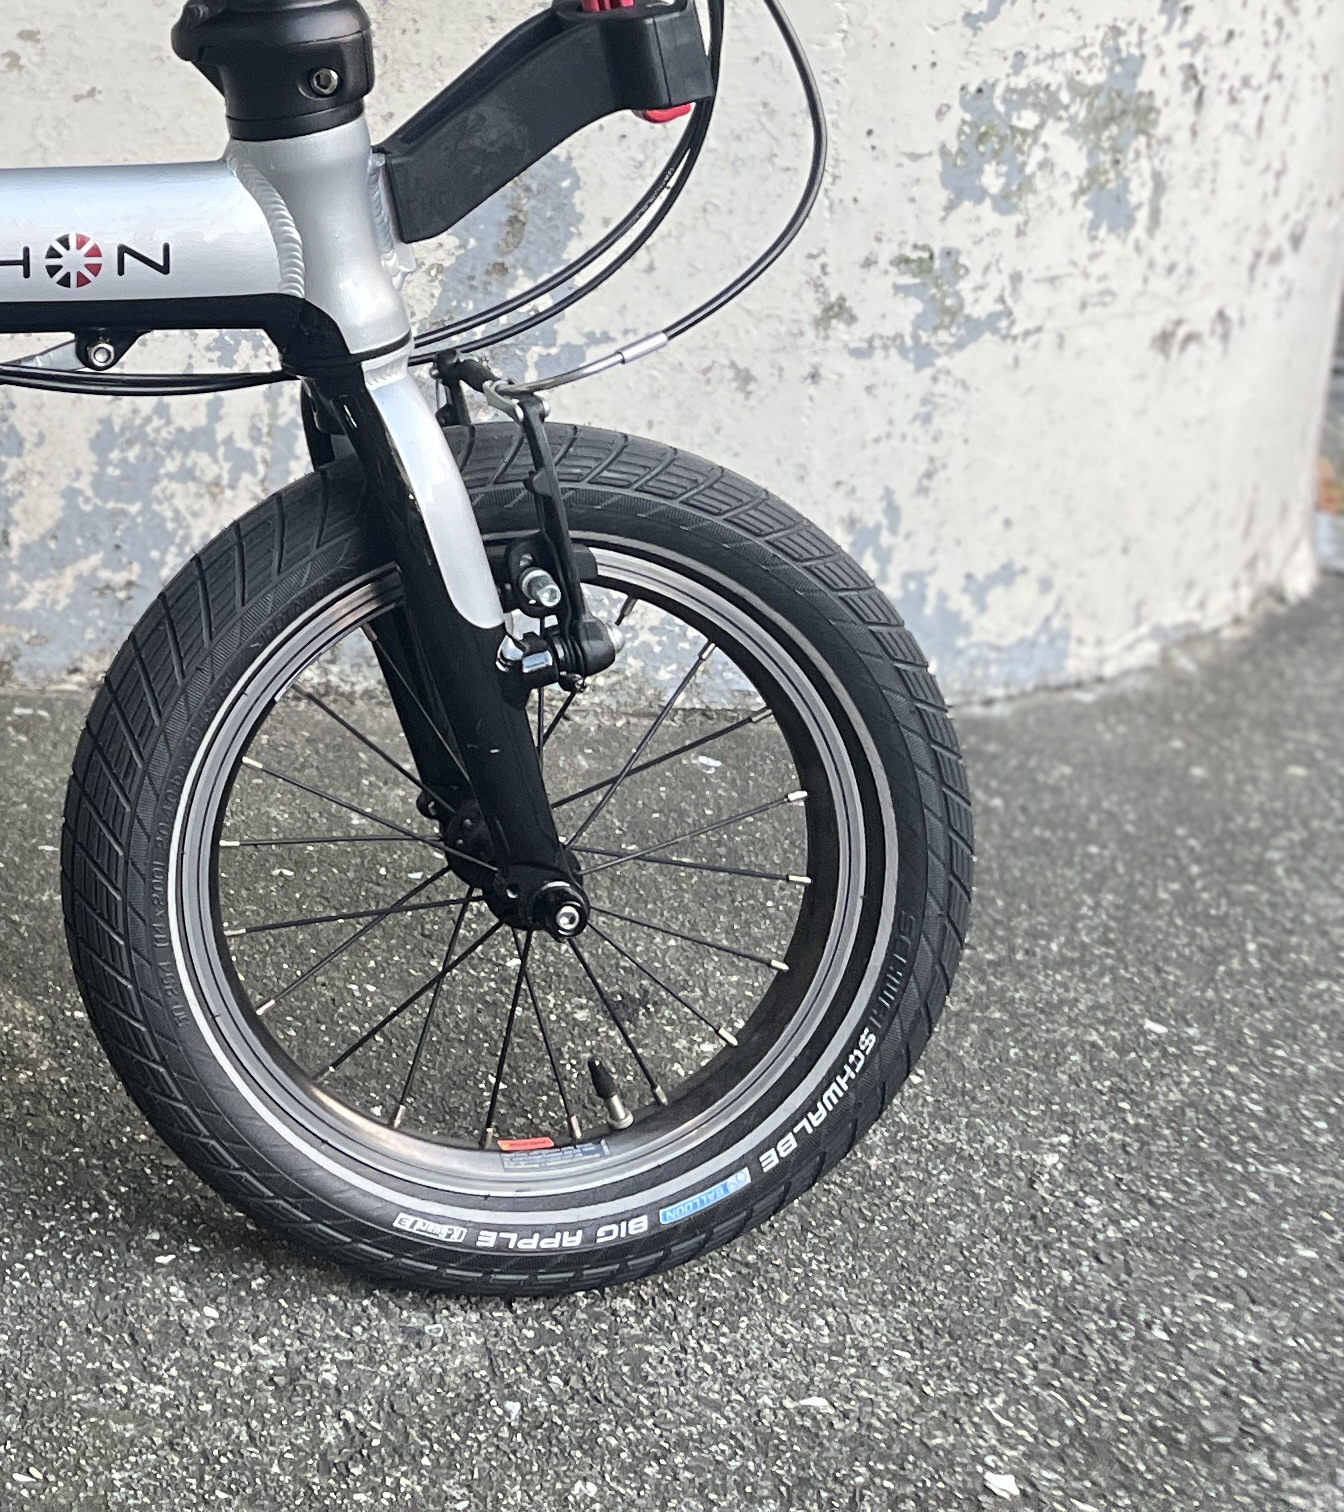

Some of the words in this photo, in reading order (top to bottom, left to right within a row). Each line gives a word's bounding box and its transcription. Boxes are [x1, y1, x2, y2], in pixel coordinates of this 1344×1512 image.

[758, 1027, 877, 1173] SCHWALBE
[475, 1229, 583, 1250] APPLE
[595, 1214, 649, 1244] BIG
